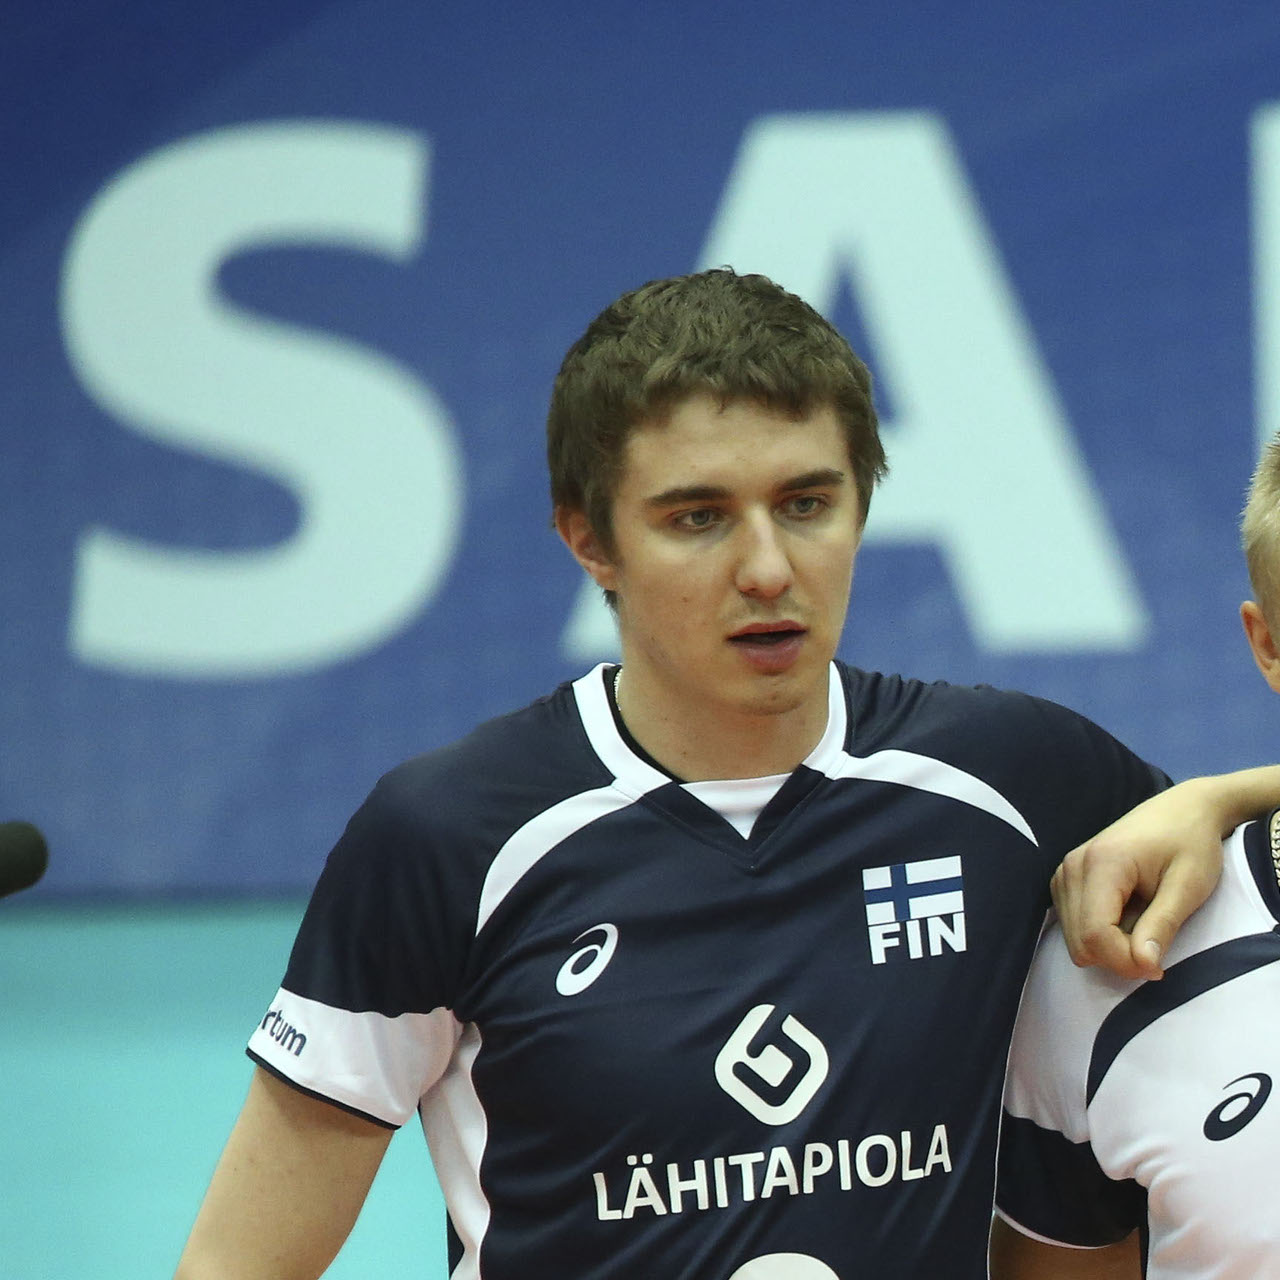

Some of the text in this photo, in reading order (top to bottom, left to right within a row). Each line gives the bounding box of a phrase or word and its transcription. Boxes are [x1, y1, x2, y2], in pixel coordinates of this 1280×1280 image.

[867, 912, 968, 965] FIN
[260, 1010, 307, 1057] rtum
[593, 1124, 952, 1221] LÄHITAPIOLA
